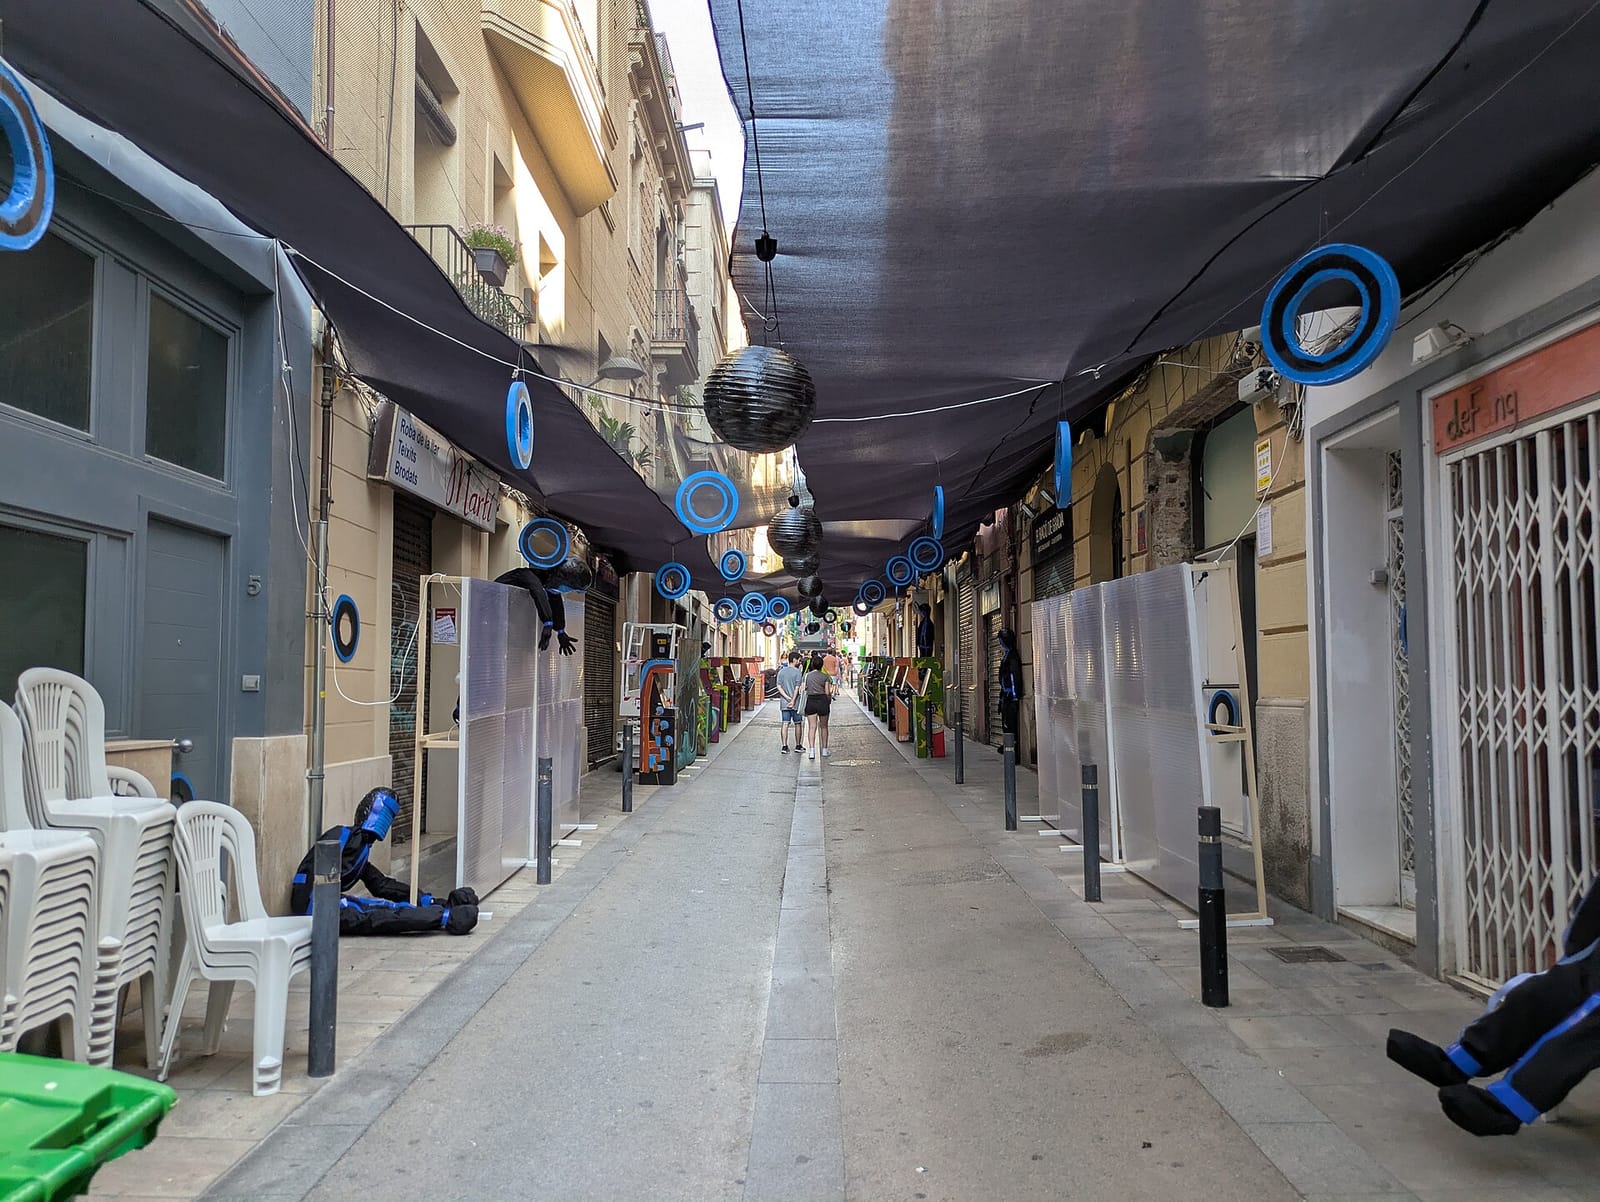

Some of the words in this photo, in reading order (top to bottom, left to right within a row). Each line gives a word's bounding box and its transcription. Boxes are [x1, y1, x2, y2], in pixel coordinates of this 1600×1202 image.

[400, 418, 417, 441] Roba
[416, 429, 424, 446] de
[398, 438, 417, 464] Teixits
[394, 460, 418, 486] Brodats
[247, 574, 262, 597] 5
